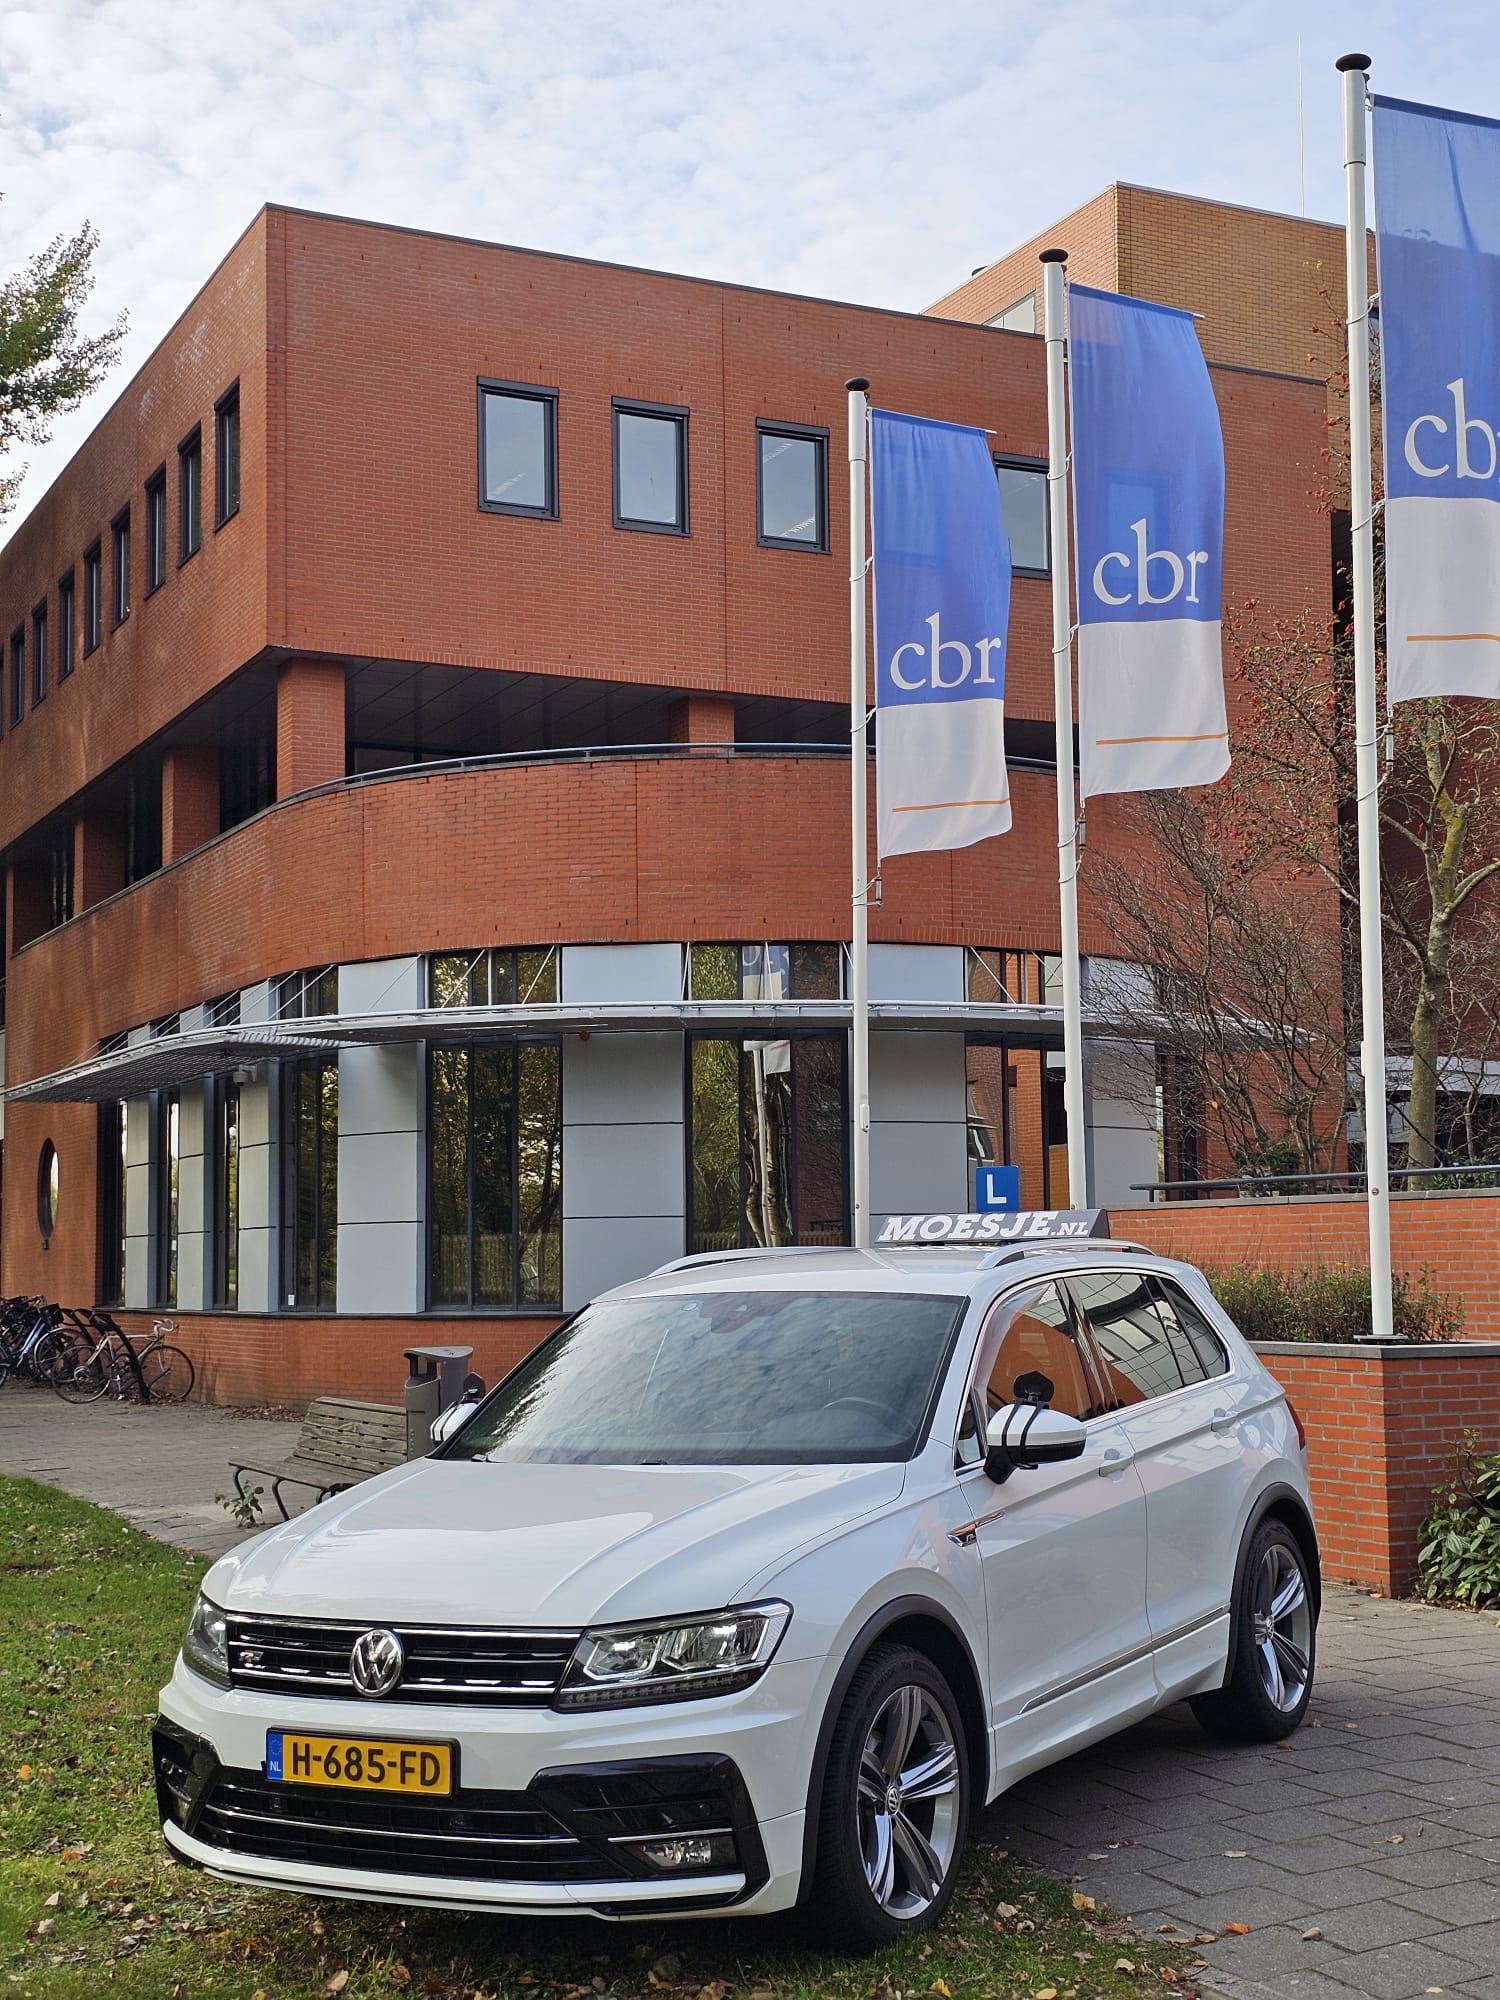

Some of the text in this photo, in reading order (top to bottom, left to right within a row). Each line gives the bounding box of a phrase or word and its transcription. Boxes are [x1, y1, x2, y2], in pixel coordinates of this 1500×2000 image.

[1404, 377, 1500, 483] cb
[1093, 518, 1208, 605] cbr
[890, 612, 1001, 689] cbr
[986, 1174, 1007, 1204] L
[877, 1211, 1088, 1240] MOESJE.NL
[269, 1742, 441, 1787] NL H-685-FD
